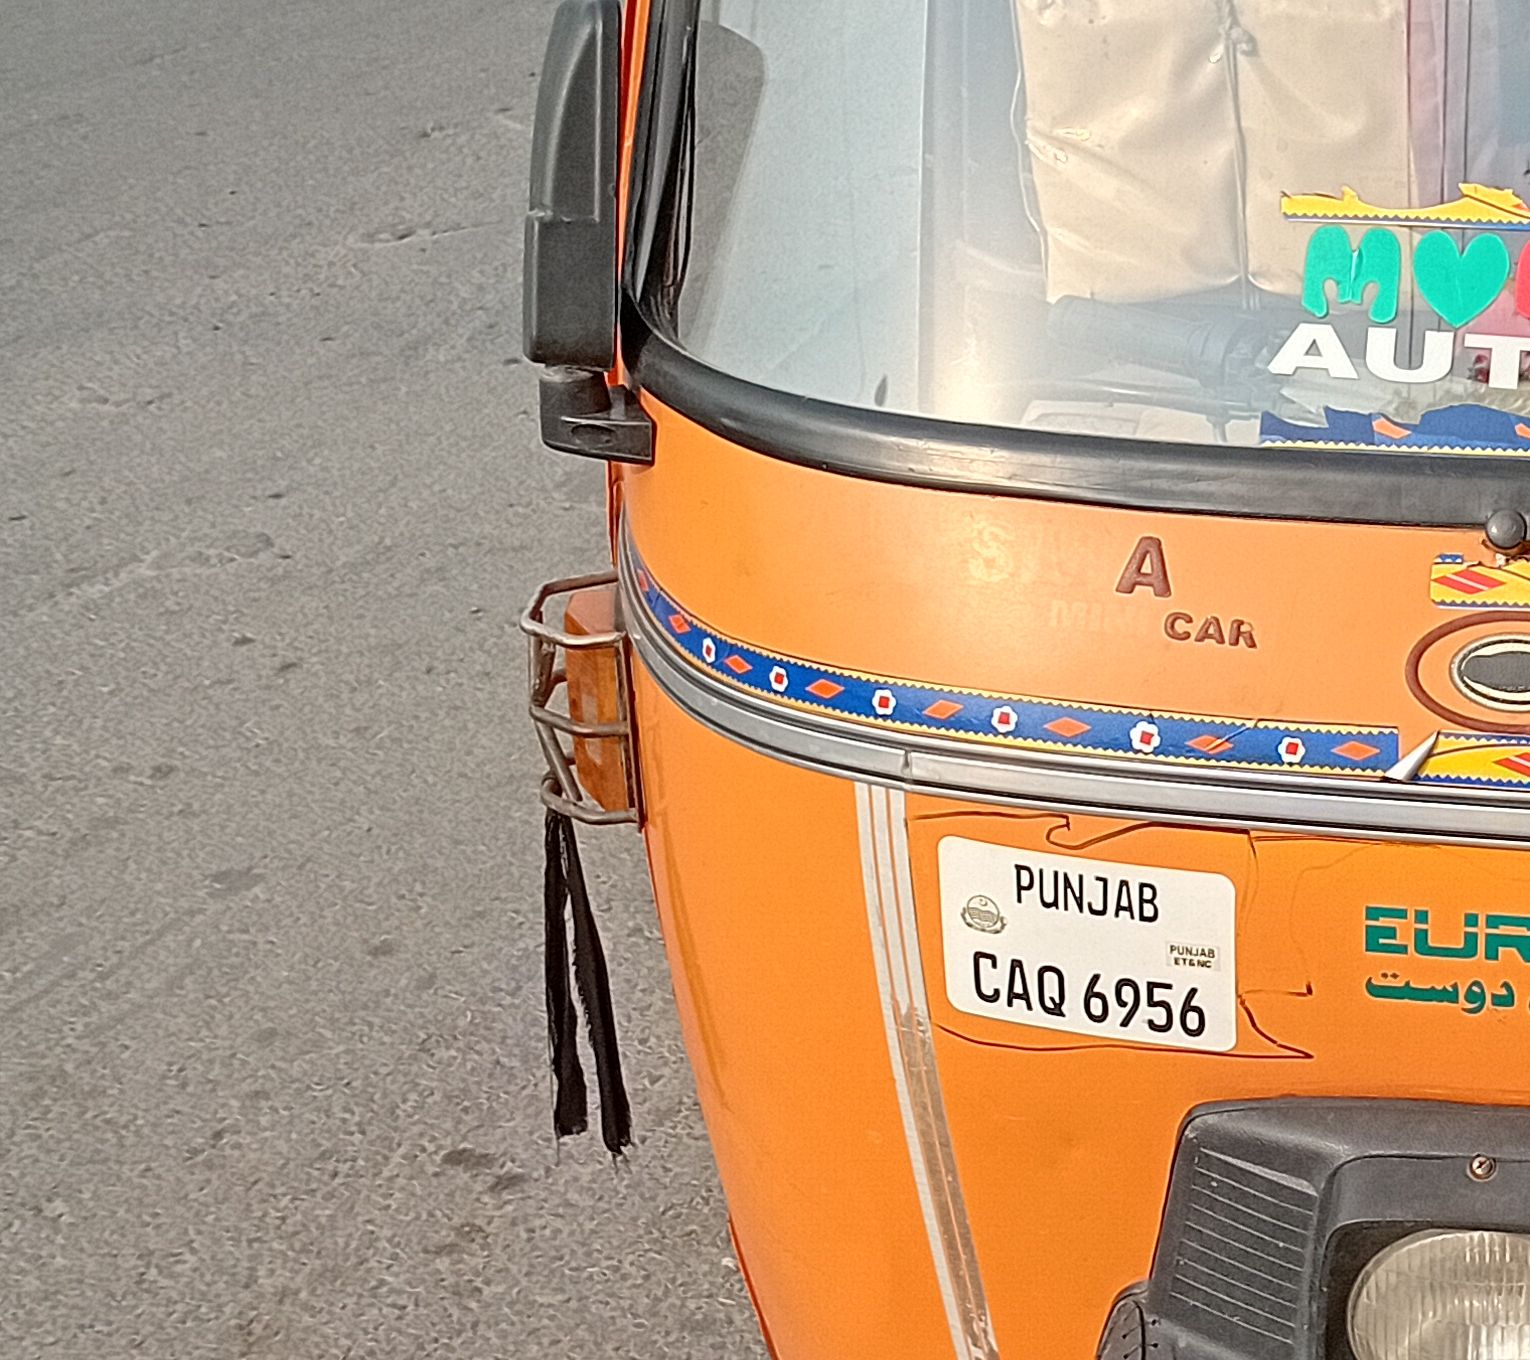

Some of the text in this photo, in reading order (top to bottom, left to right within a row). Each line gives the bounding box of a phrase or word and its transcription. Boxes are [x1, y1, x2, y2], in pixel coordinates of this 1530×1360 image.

[1164, 612, 1257, 649] CAR
[1014, 863, 1159, 923] PUNJAB
[1170, 944, 1215, 959] PUNJAB
[973, 951, 1206, 1038] CAQ 6956
[1365, 972, 1515, 1015] دوست
